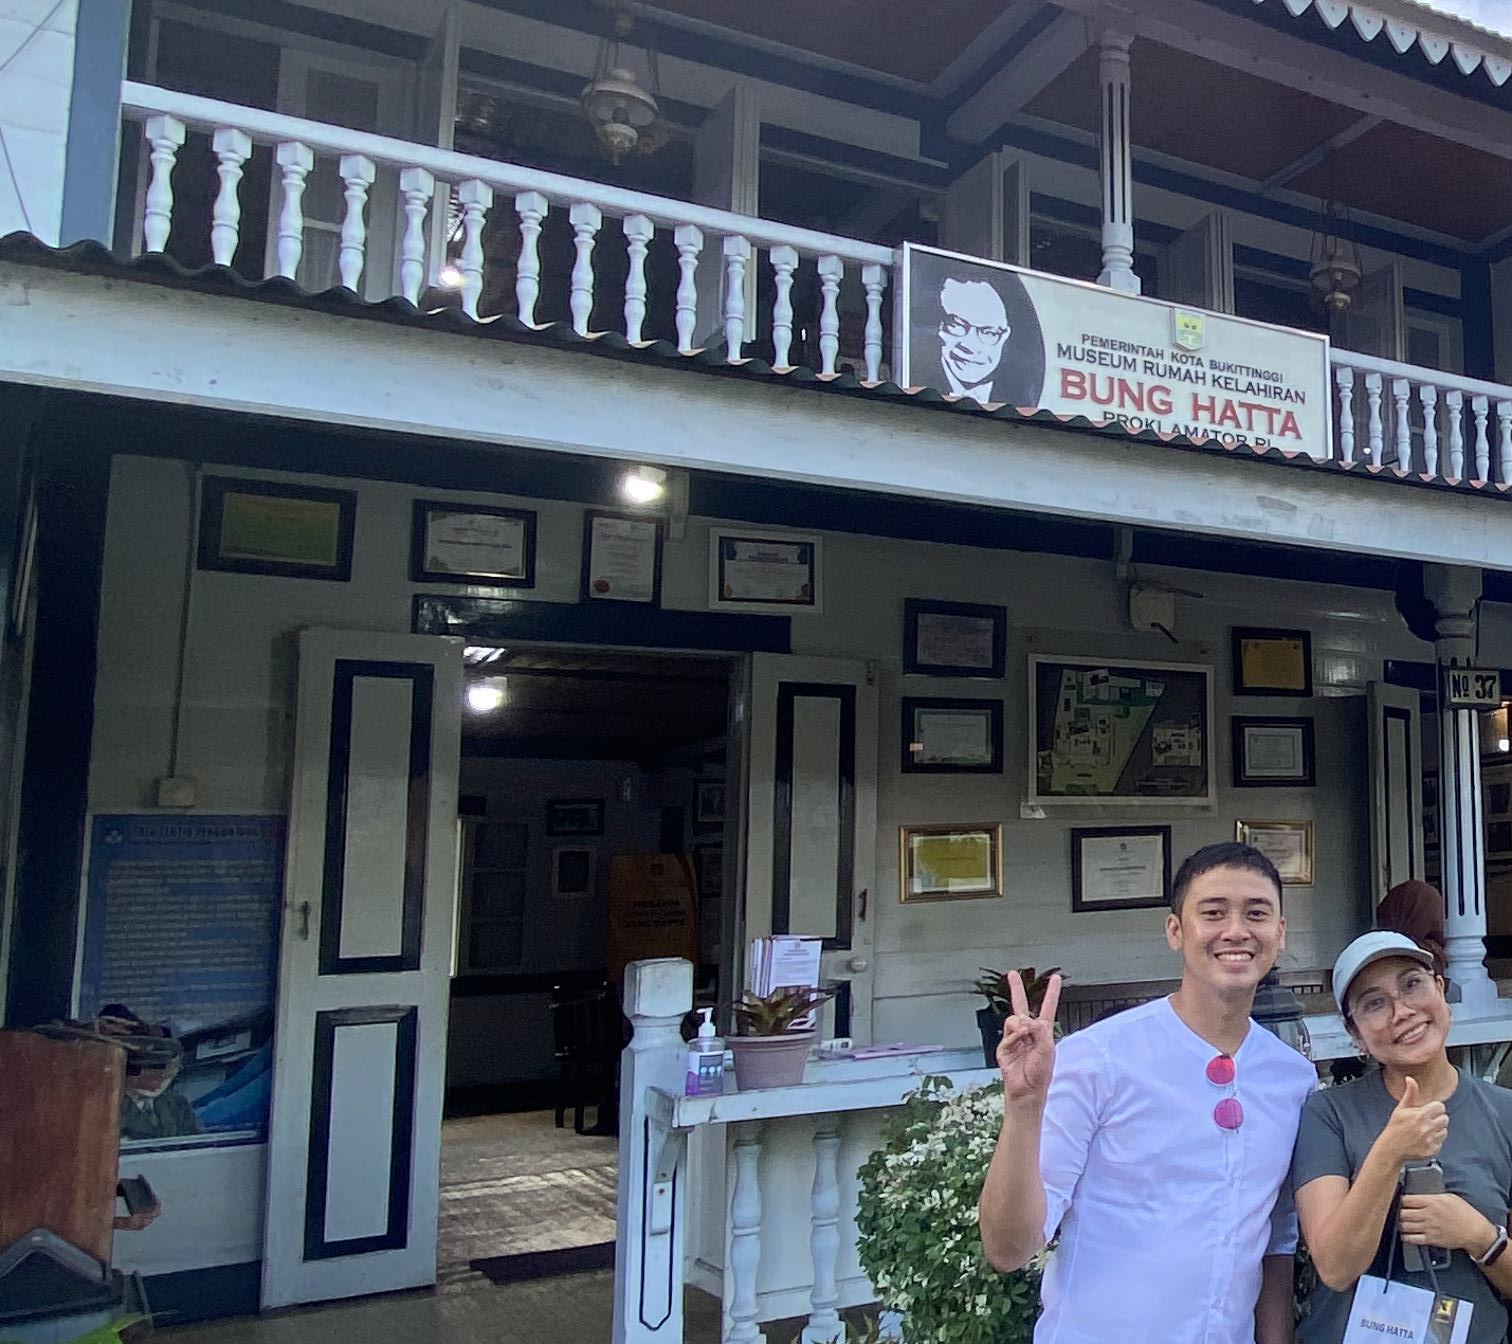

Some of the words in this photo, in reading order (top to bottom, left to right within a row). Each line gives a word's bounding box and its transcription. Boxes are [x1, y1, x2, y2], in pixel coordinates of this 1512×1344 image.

[1056, 343, 1137, 372] MUSEUM
[1143, 360, 1206, 386] RUMAH
[1211, 375, 1306, 405] KELAHIRAN
[1081, 333, 1164, 360] PEMERINTAH
[1171, 351, 1204, 368] KOTA
[1209, 359, 1283, 384] BUKITTINGGI
[1060, 367, 1173, 415] BUNG
[1191, 391, 1303, 440] HATTA
[1474, 674, 1497, 699] 37
[1360, 1318, 1385, 1333] BUNG
[1386, 1325, 1414, 1340] HATTA
